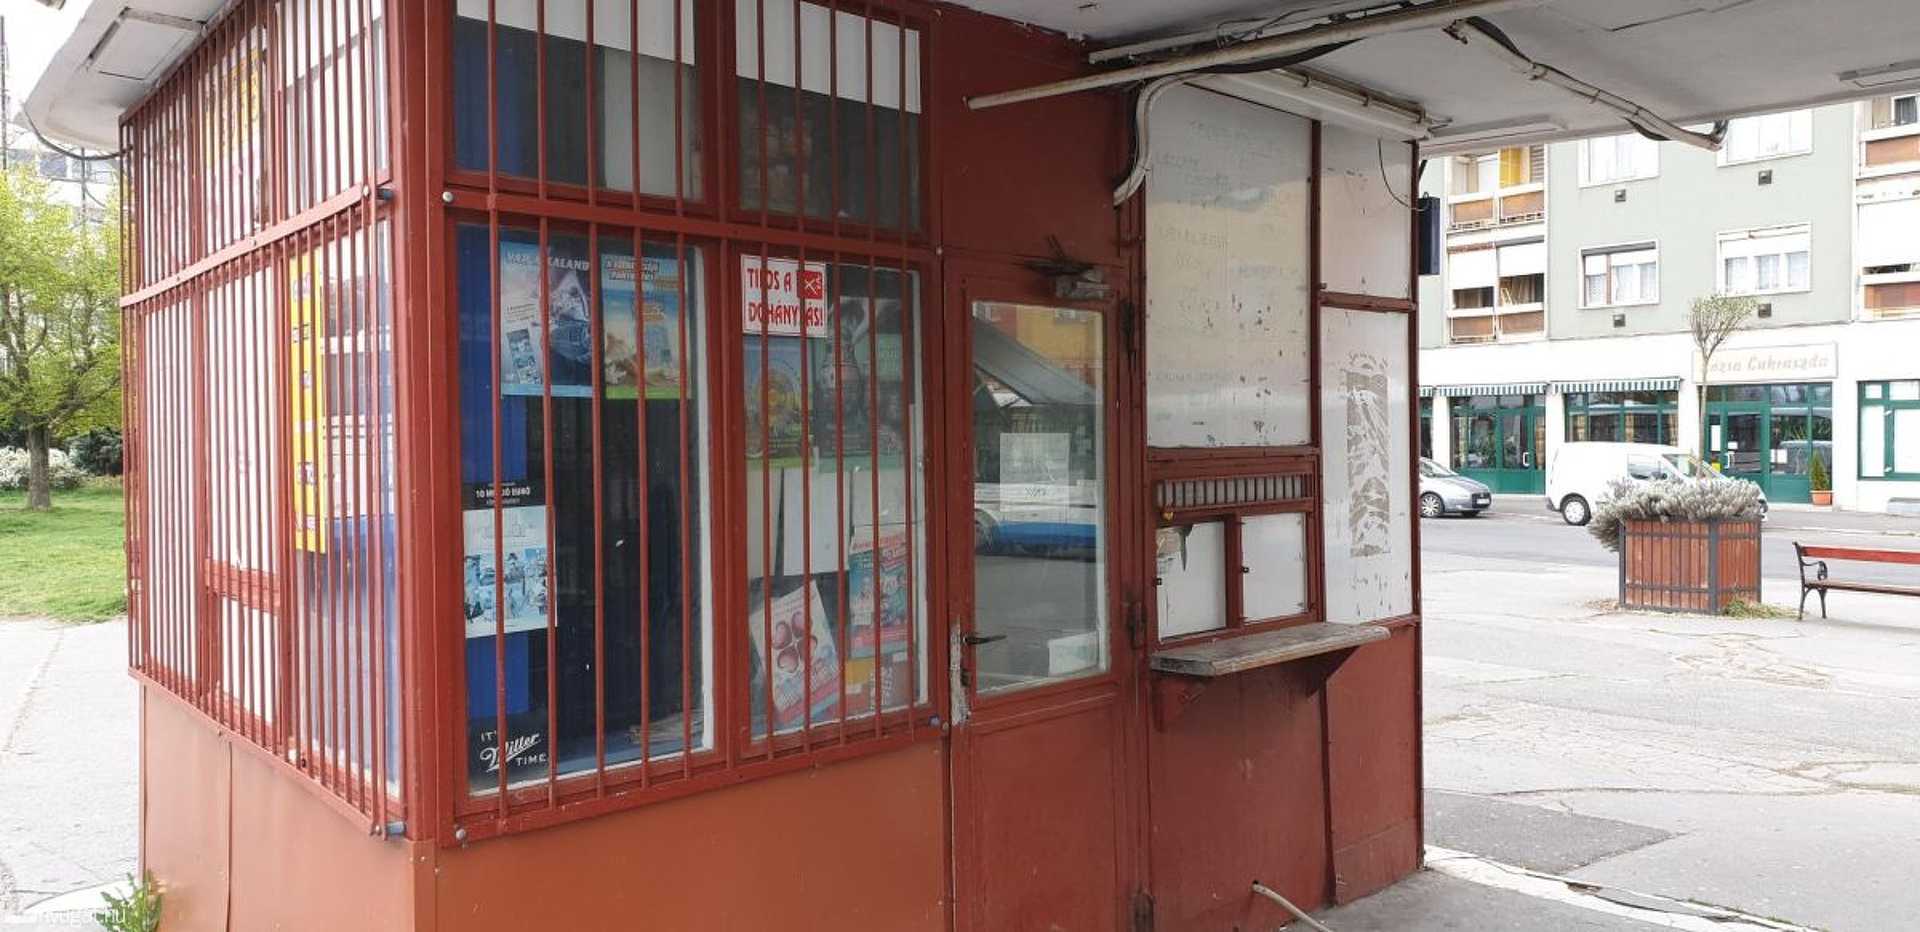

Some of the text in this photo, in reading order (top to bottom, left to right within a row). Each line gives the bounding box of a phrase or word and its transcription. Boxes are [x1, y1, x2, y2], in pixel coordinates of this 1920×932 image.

[747, 268, 792, 293] TIOS A
[748, 301, 823, 327] DOHÁNYÁS!
[481, 730, 497, 742] IT'
